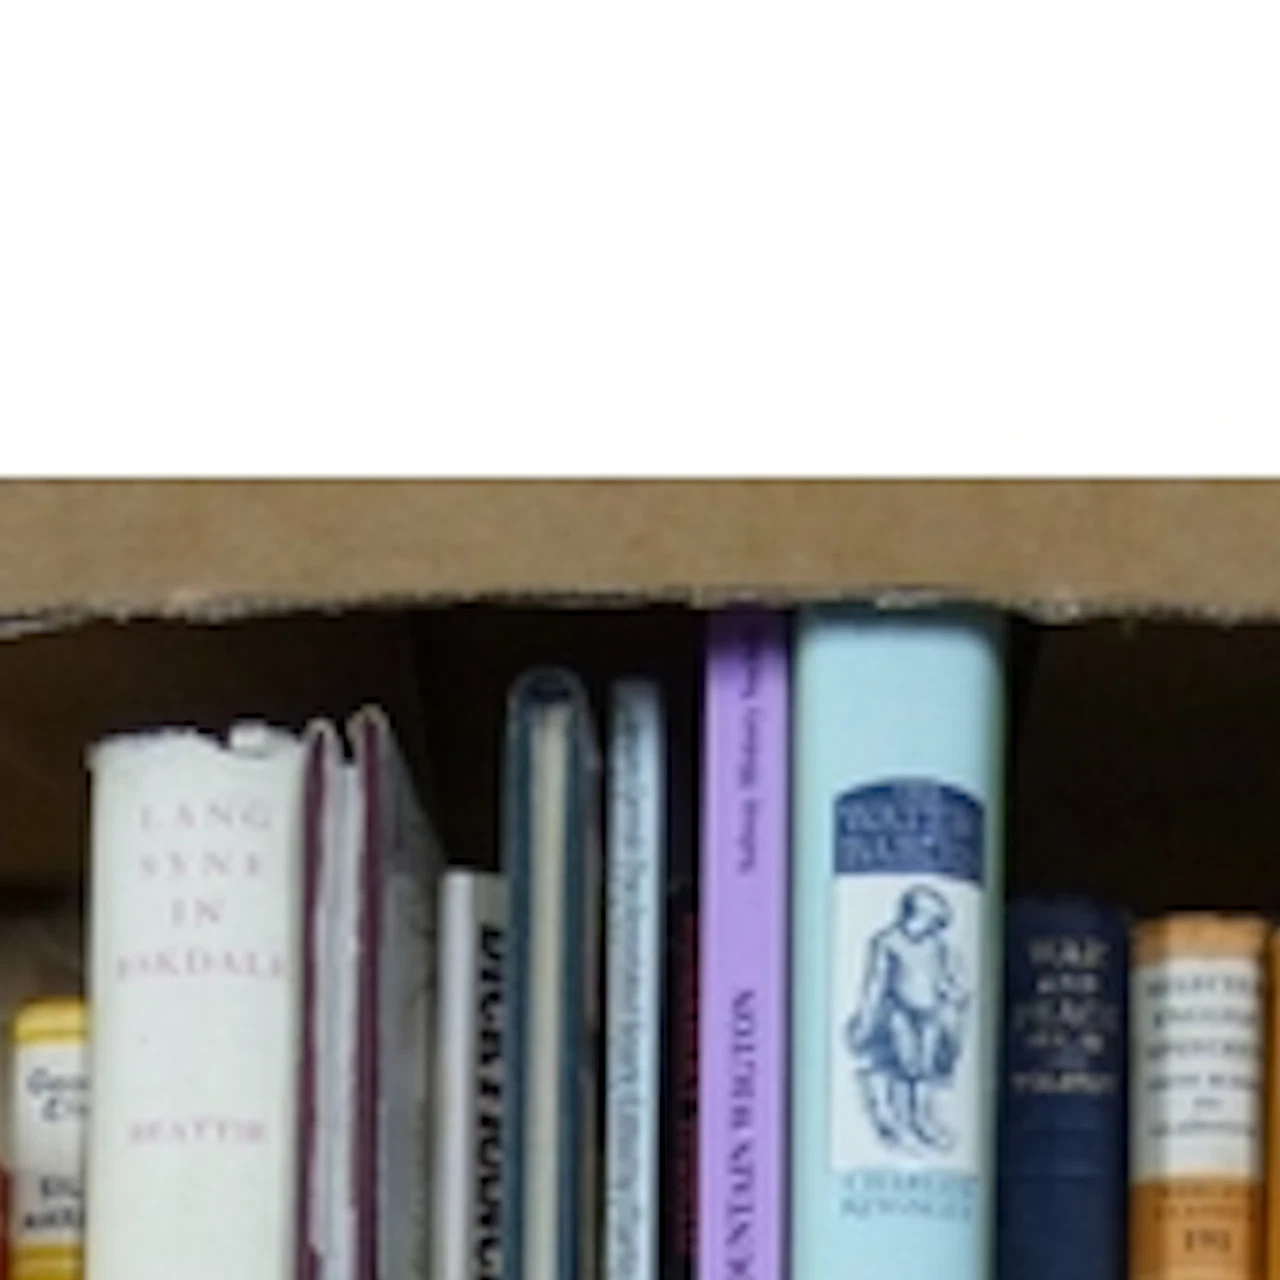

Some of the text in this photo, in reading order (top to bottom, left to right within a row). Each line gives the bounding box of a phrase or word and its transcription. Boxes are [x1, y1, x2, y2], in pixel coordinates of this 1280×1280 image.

[140, 803, 272, 834] LANG
[140, 850, 260, 881] SYNE
[171, 897, 222, 926] IN
